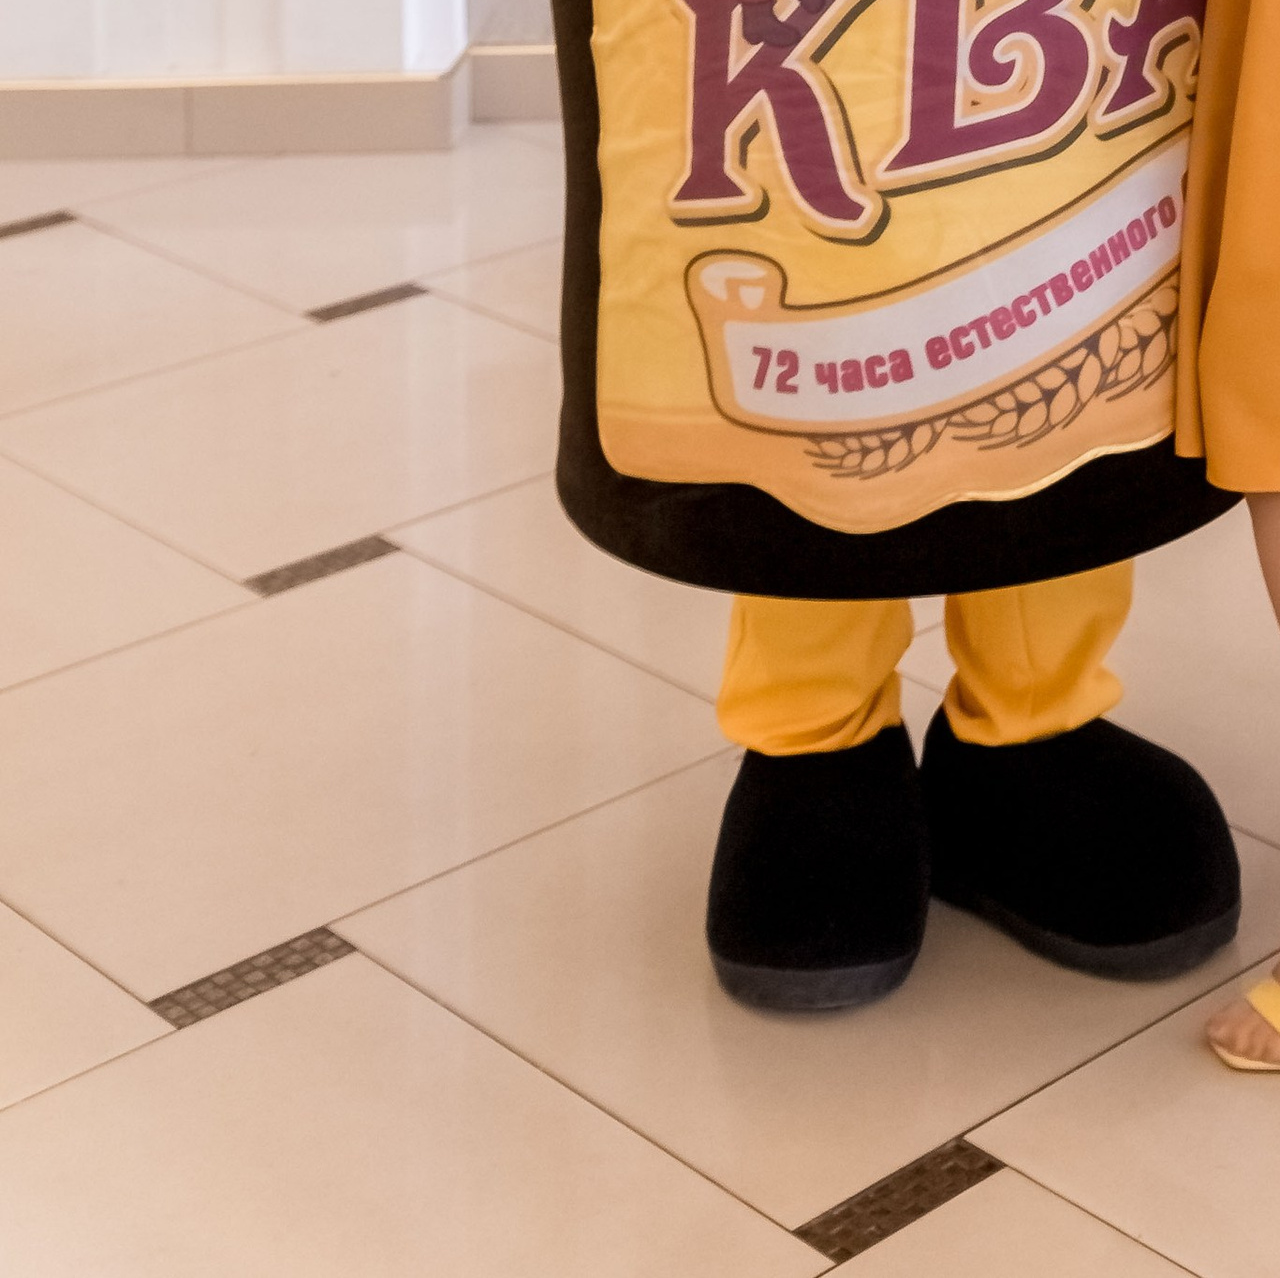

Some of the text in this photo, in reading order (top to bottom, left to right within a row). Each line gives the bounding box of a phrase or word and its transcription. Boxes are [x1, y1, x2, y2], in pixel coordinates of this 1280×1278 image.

[752, 194, 1177, 395] 72 часа естественного
